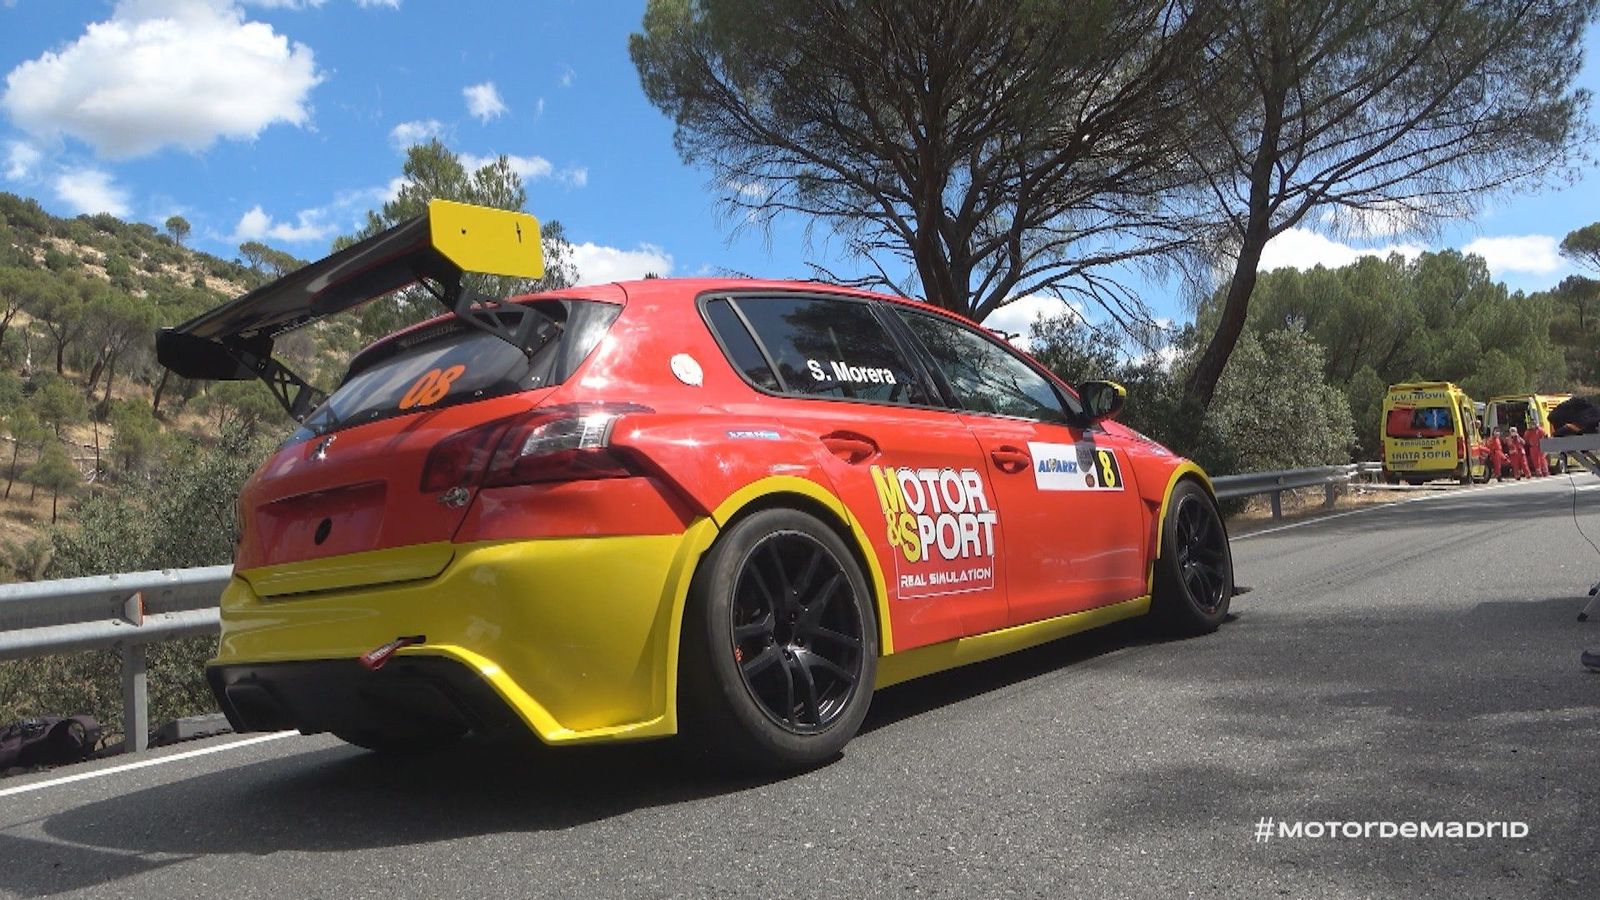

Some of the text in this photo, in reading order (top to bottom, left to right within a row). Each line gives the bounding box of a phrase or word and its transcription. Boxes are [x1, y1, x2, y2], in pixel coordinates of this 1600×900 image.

[807, 359, 896, 384] S. Morera
[399, 365, 465, 409] 08
[1038, 458, 1078, 475] ALVAREZ
[1392, 450, 1451, 460] SANTA SOFIA
[1099, 450, 1116, 488] 8
[870, 465, 990, 514] MOTOR
[900, 567, 992, 588] REAL SIMULATION
